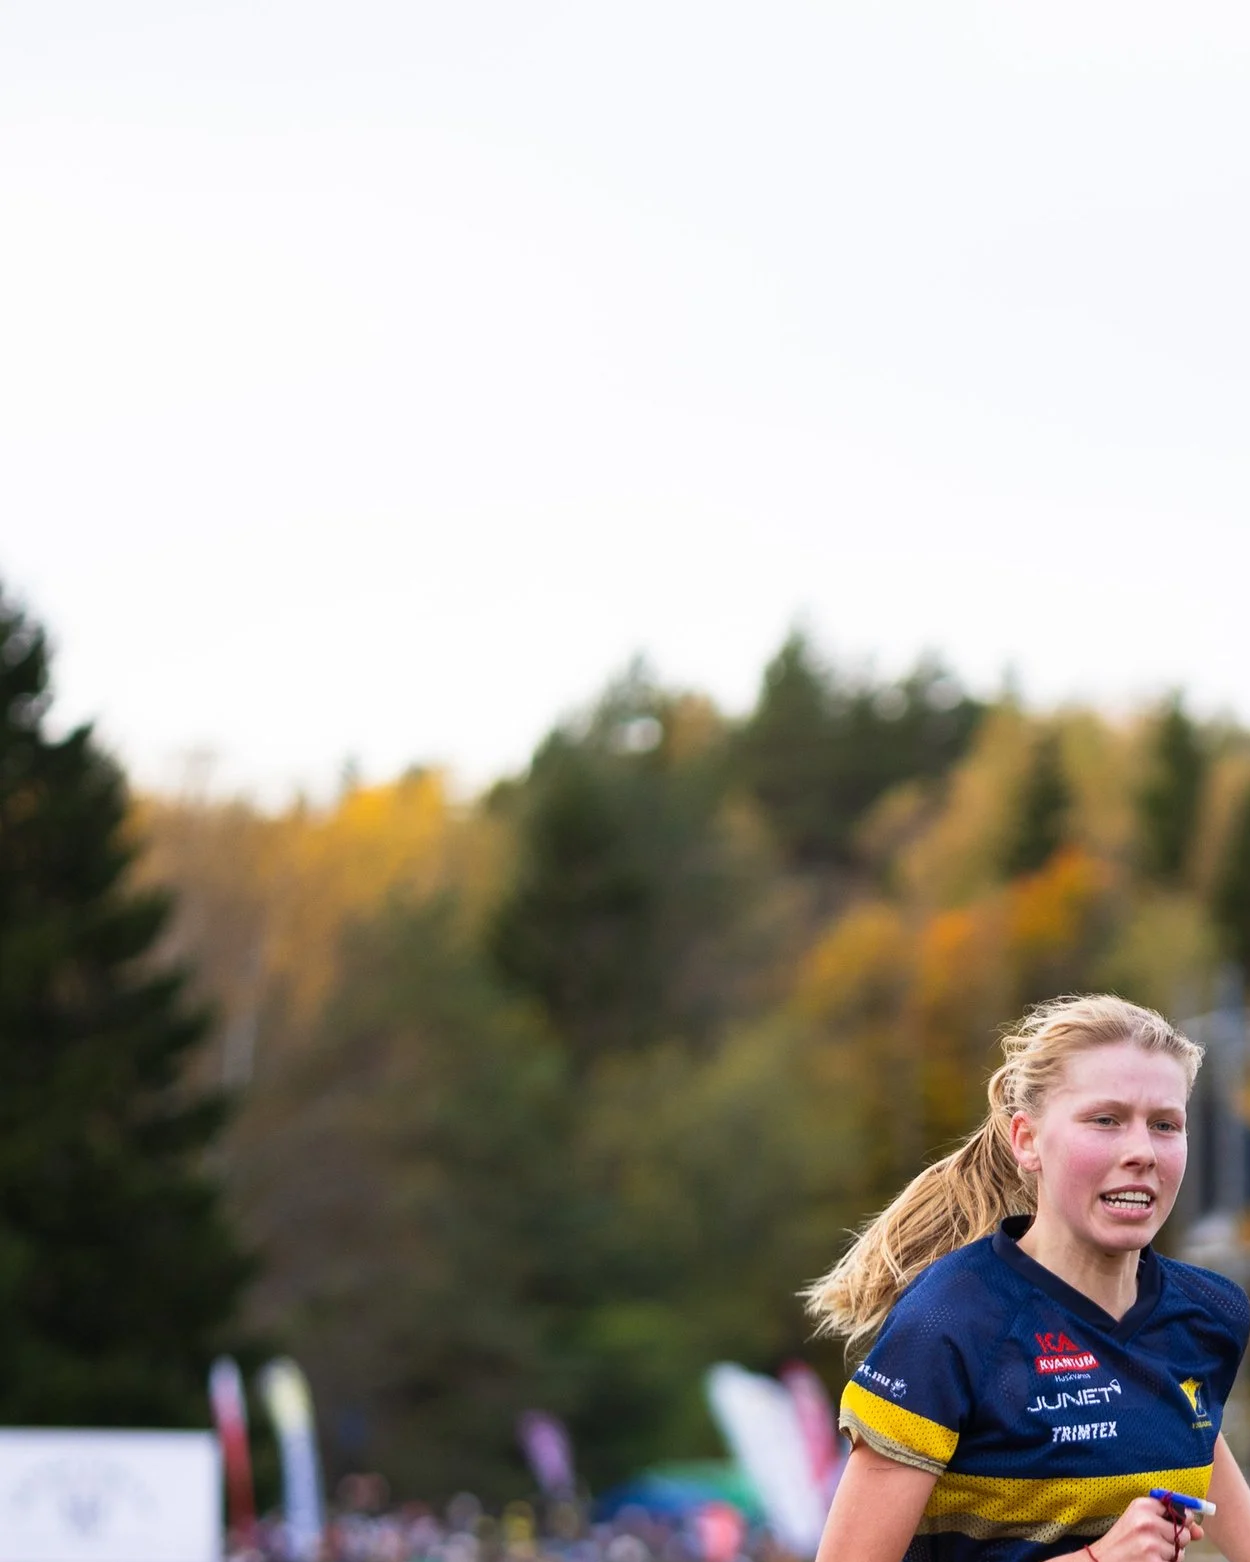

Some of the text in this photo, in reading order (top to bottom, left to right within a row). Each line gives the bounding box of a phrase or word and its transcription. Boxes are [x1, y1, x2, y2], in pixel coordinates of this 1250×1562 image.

[1035, 1332, 1080, 1353] ICA
[1039, 1354, 1096, 1370] KVANTUM
[1027, 1386, 1114, 1412] JUNET
[1052, 1421, 1118, 1442] TRIMTEX
